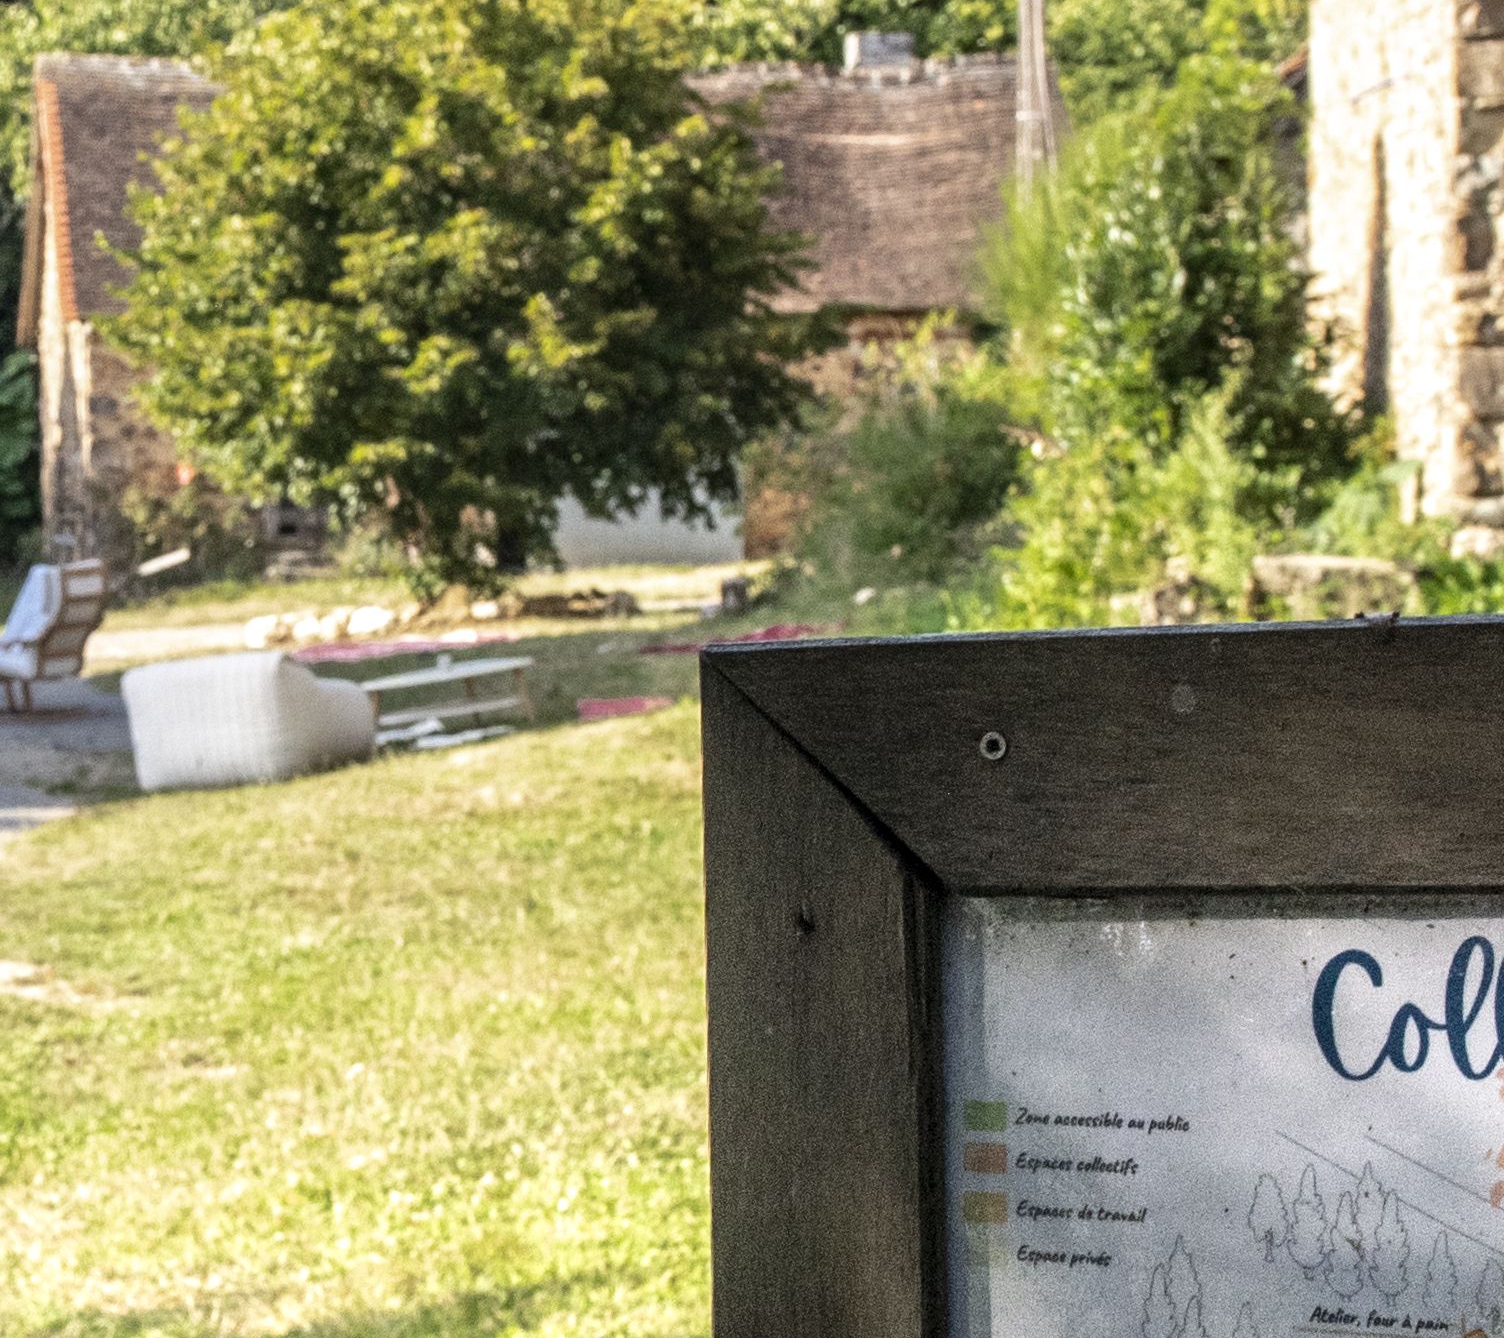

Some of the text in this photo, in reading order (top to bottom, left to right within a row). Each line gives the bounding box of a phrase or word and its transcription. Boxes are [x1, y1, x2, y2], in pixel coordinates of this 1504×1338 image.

[1015, 1107, 1190, 1134] Zone accessible au public
[1015, 1152, 1138, 1175] Espaces collectifs
[1016, 1200, 1147, 1223] Espaces de travail
[1017, 1245, 1066, 1267] Espace
[1309, 1306, 1449, 1333] Atelier, four à pain
